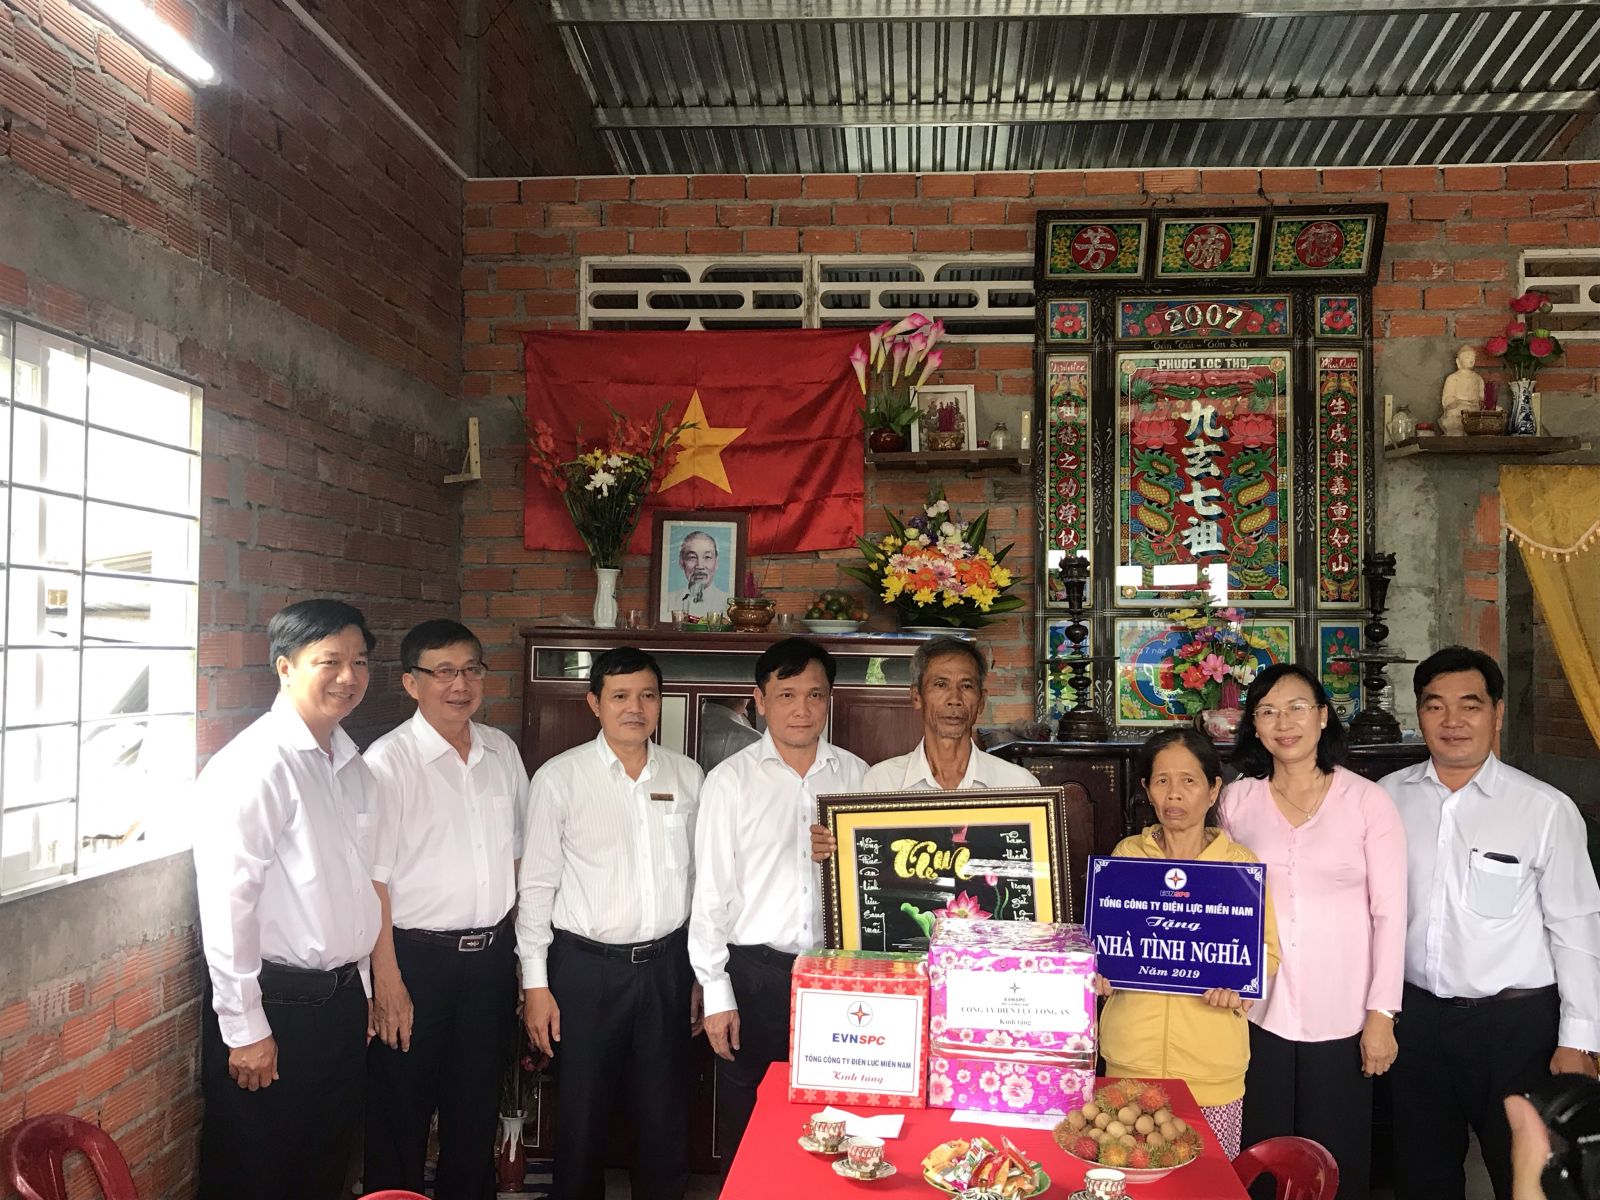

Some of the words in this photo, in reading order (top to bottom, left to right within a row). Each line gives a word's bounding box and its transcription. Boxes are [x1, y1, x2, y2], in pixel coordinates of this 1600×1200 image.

[1075, 226, 1119, 270] 芳
[1165, 304, 1243, 332] 2007
[1180, 400, 1228, 558] 九玄七祖
[1099, 896, 1122, 909] TỔNG
[1124, 898, 1148, 910] CÔNG
[1150, 901, 1161, 911] TY
[1162, 900, 1184, 914] ĐIỆN
[1186, 902, 1203, 914] LỰC
[1205, 902, 1229, 915] MIỀN
[1232, 906, 1253, 916] NAM
[1145, 916, 1202, 931] Tặng
[1096, 931, 1134, 958] NHÀ
[1140, 932, 1186, 961] TÌNH
[1190, 938, 1252, 966] NGHĨA
[1138, 965, 1168, 977] Năm
[1171, 968, 1200, 979] 2019
[832, 1032, 886, 1046] EVNSPC
[823, 1055, 841, 1064] CÔNG
[897, 1061, 912, 1069] NAM
